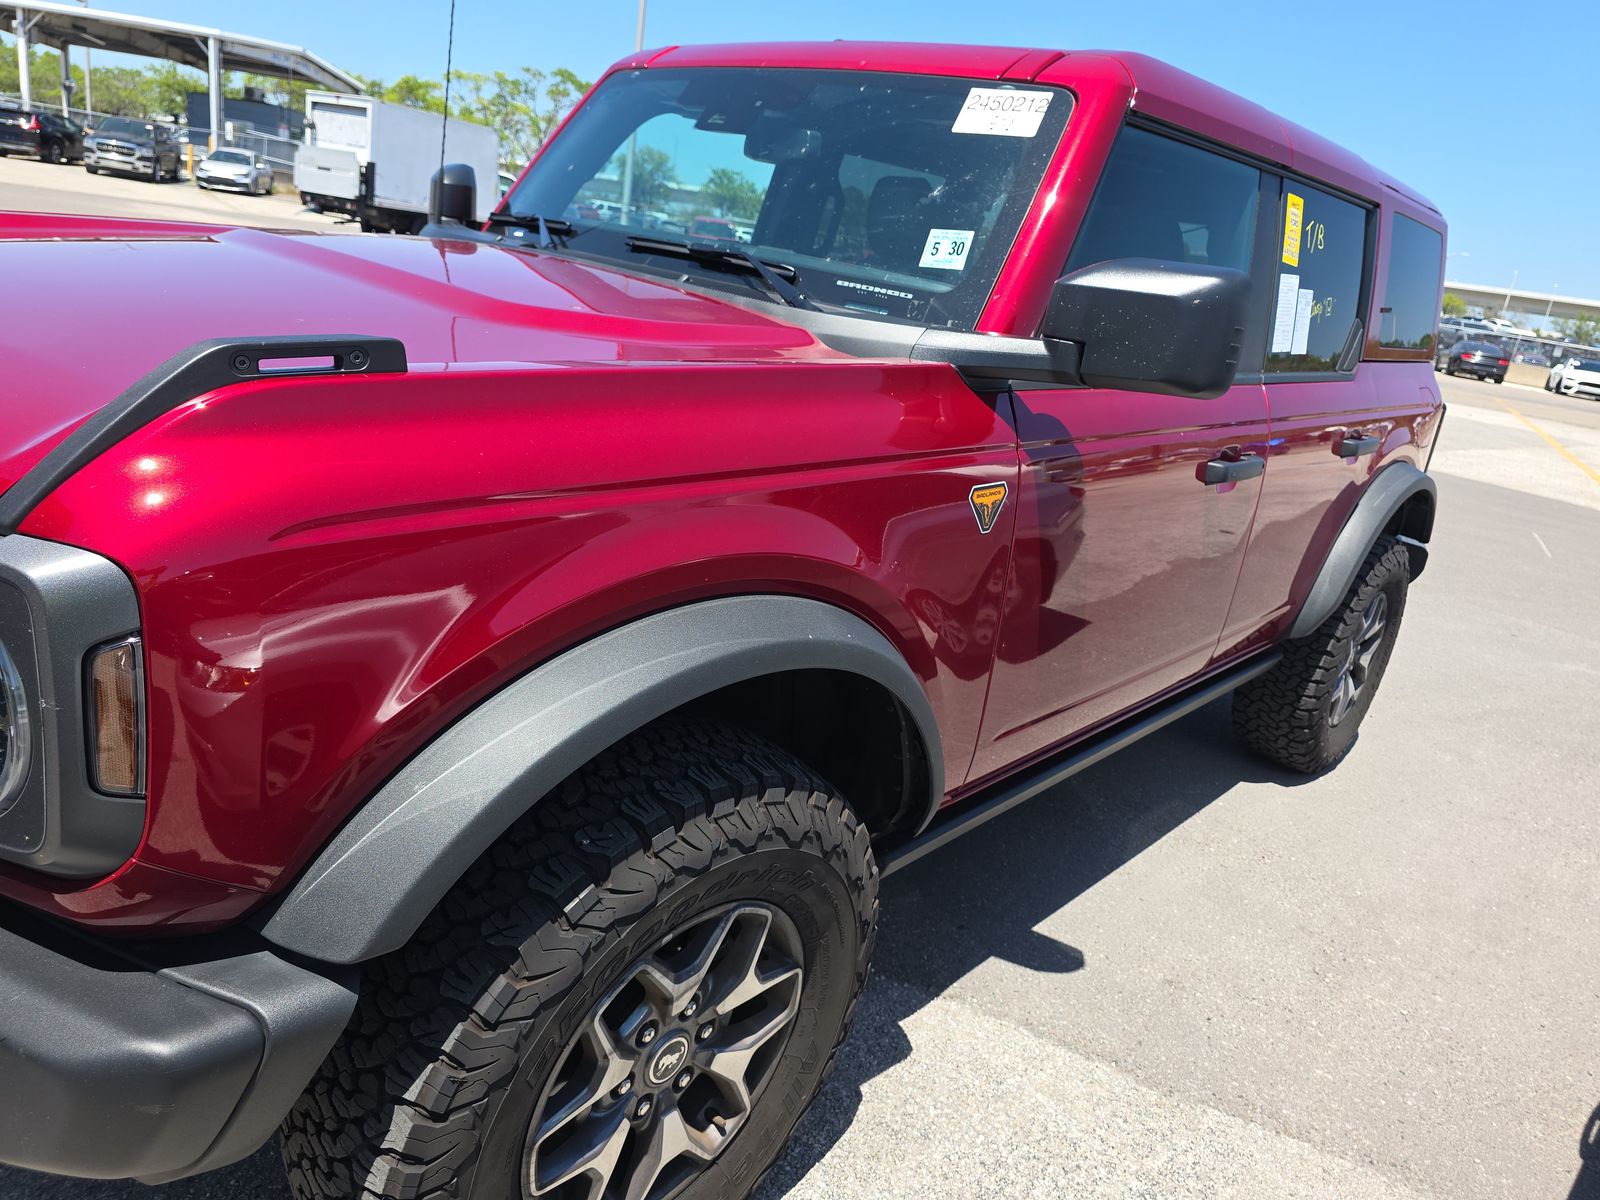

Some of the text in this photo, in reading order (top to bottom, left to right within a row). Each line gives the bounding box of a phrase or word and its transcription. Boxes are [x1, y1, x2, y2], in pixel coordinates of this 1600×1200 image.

[967, 94, 1050, 113] 2450212
[930, 240, 965, 256] 5 30
[836, 280, 914, 299] BRONCO
[976, 490, 1002, 499] BADLANDS
